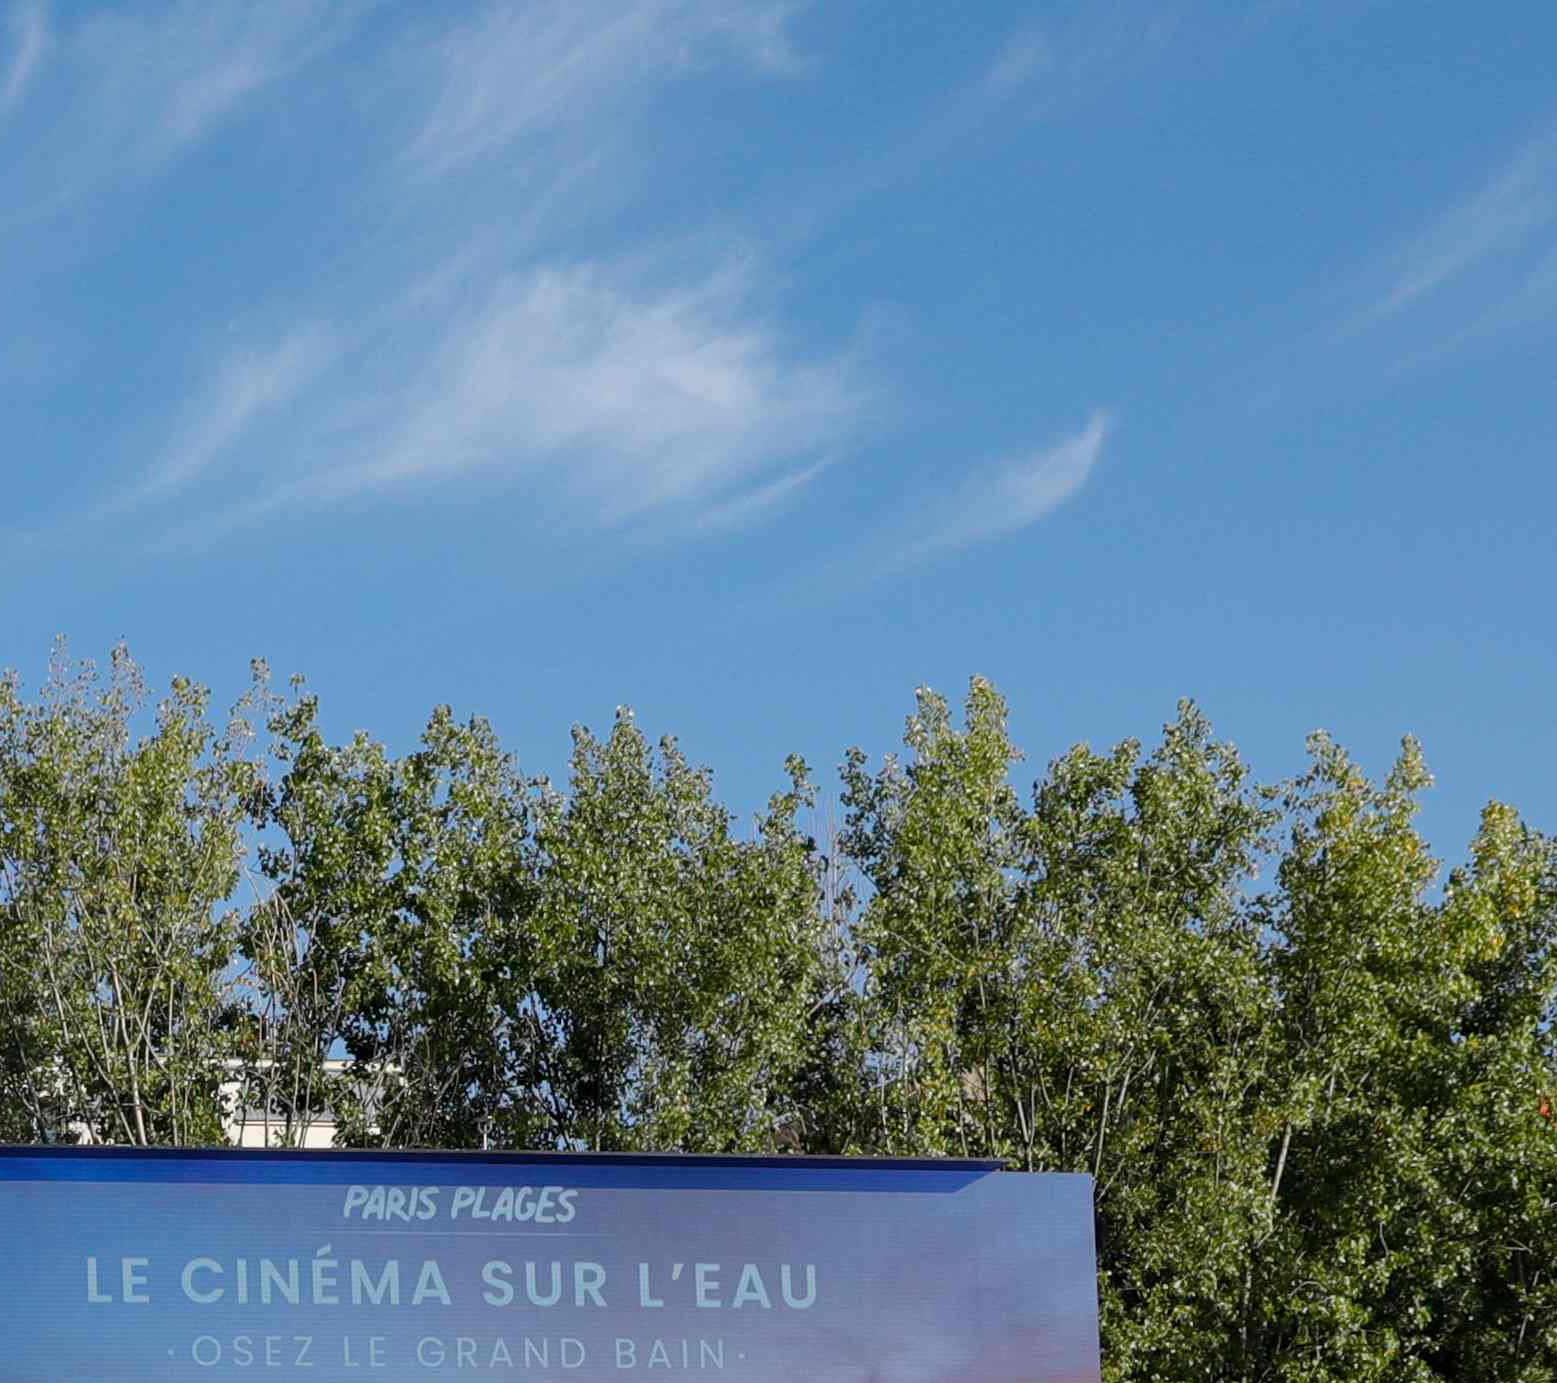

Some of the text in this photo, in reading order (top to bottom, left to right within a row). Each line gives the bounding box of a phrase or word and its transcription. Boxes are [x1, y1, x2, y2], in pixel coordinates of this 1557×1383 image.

[343, 1185, 581, 1223] PARIS PLAGES
[86, 1243, 818, 1310] LE CINÉMA SUR L'EAU
[191, 1336, 726, 1371] OSEZ LE GRAND BAIN
